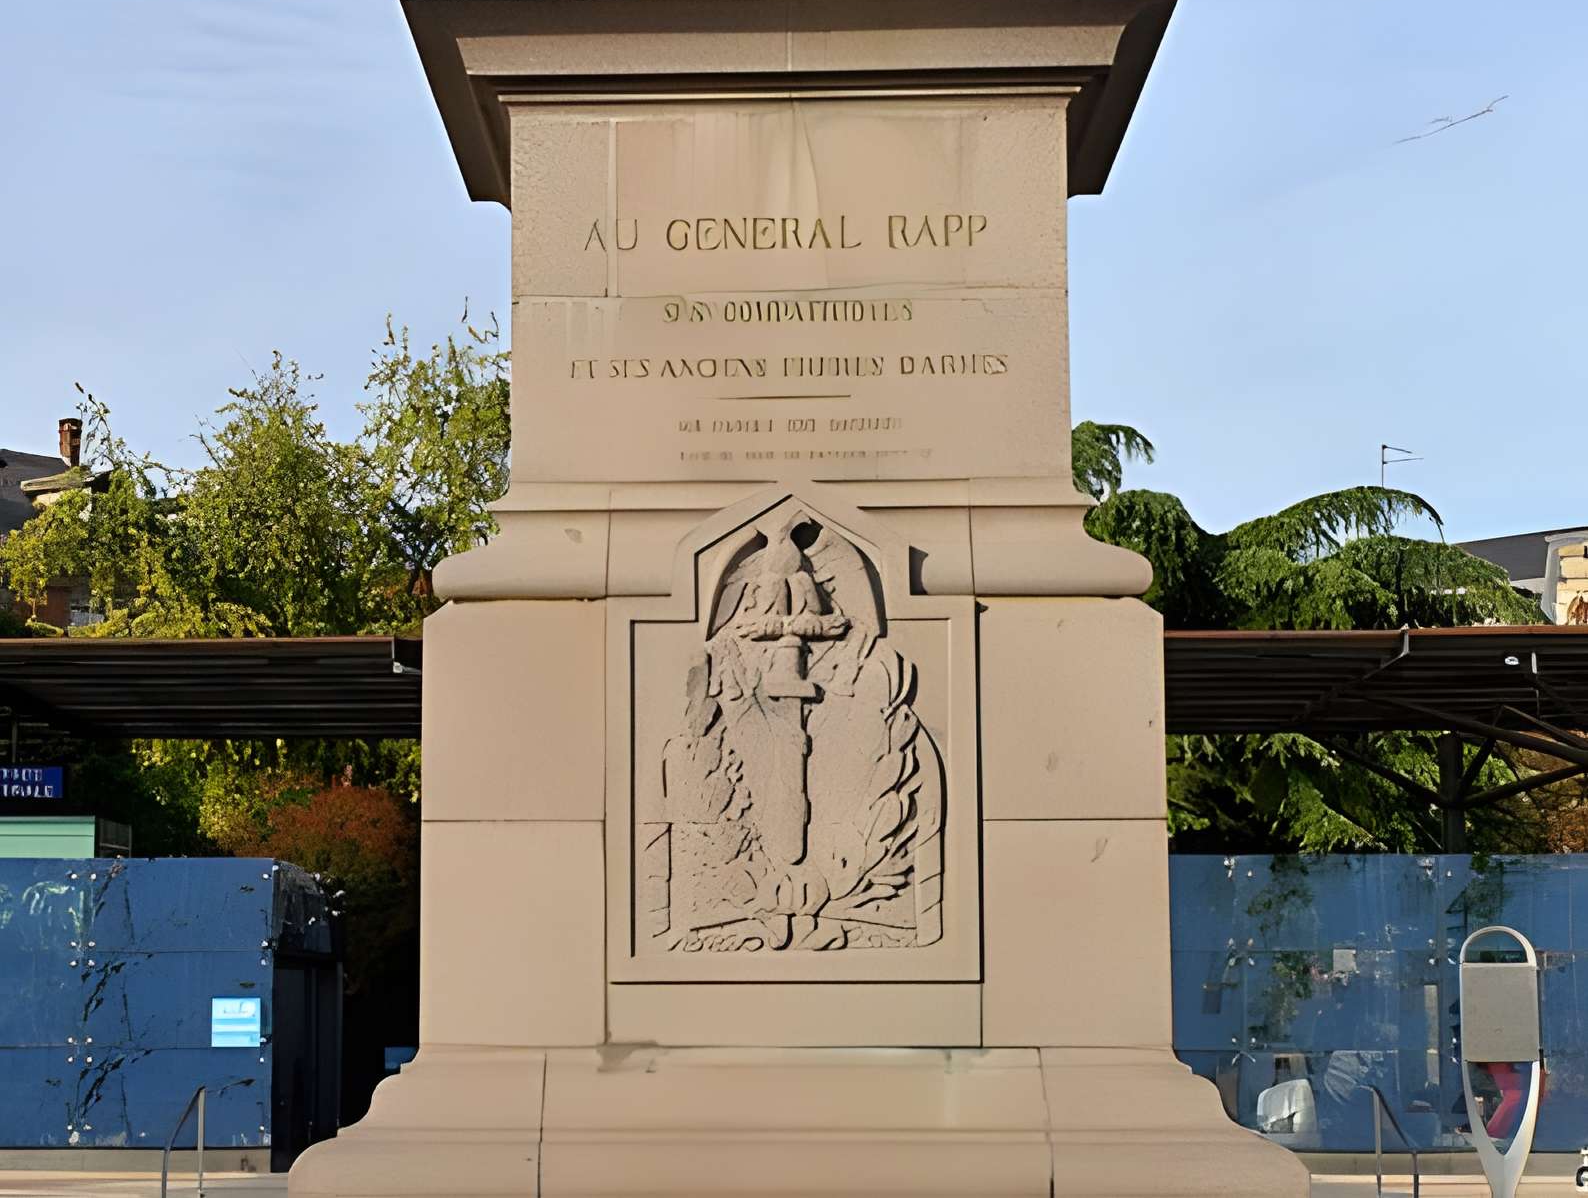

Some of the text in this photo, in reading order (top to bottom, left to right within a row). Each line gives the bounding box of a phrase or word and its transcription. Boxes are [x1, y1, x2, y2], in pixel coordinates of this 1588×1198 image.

[584, 214, 988, 252] AU GENERAL RAPP
